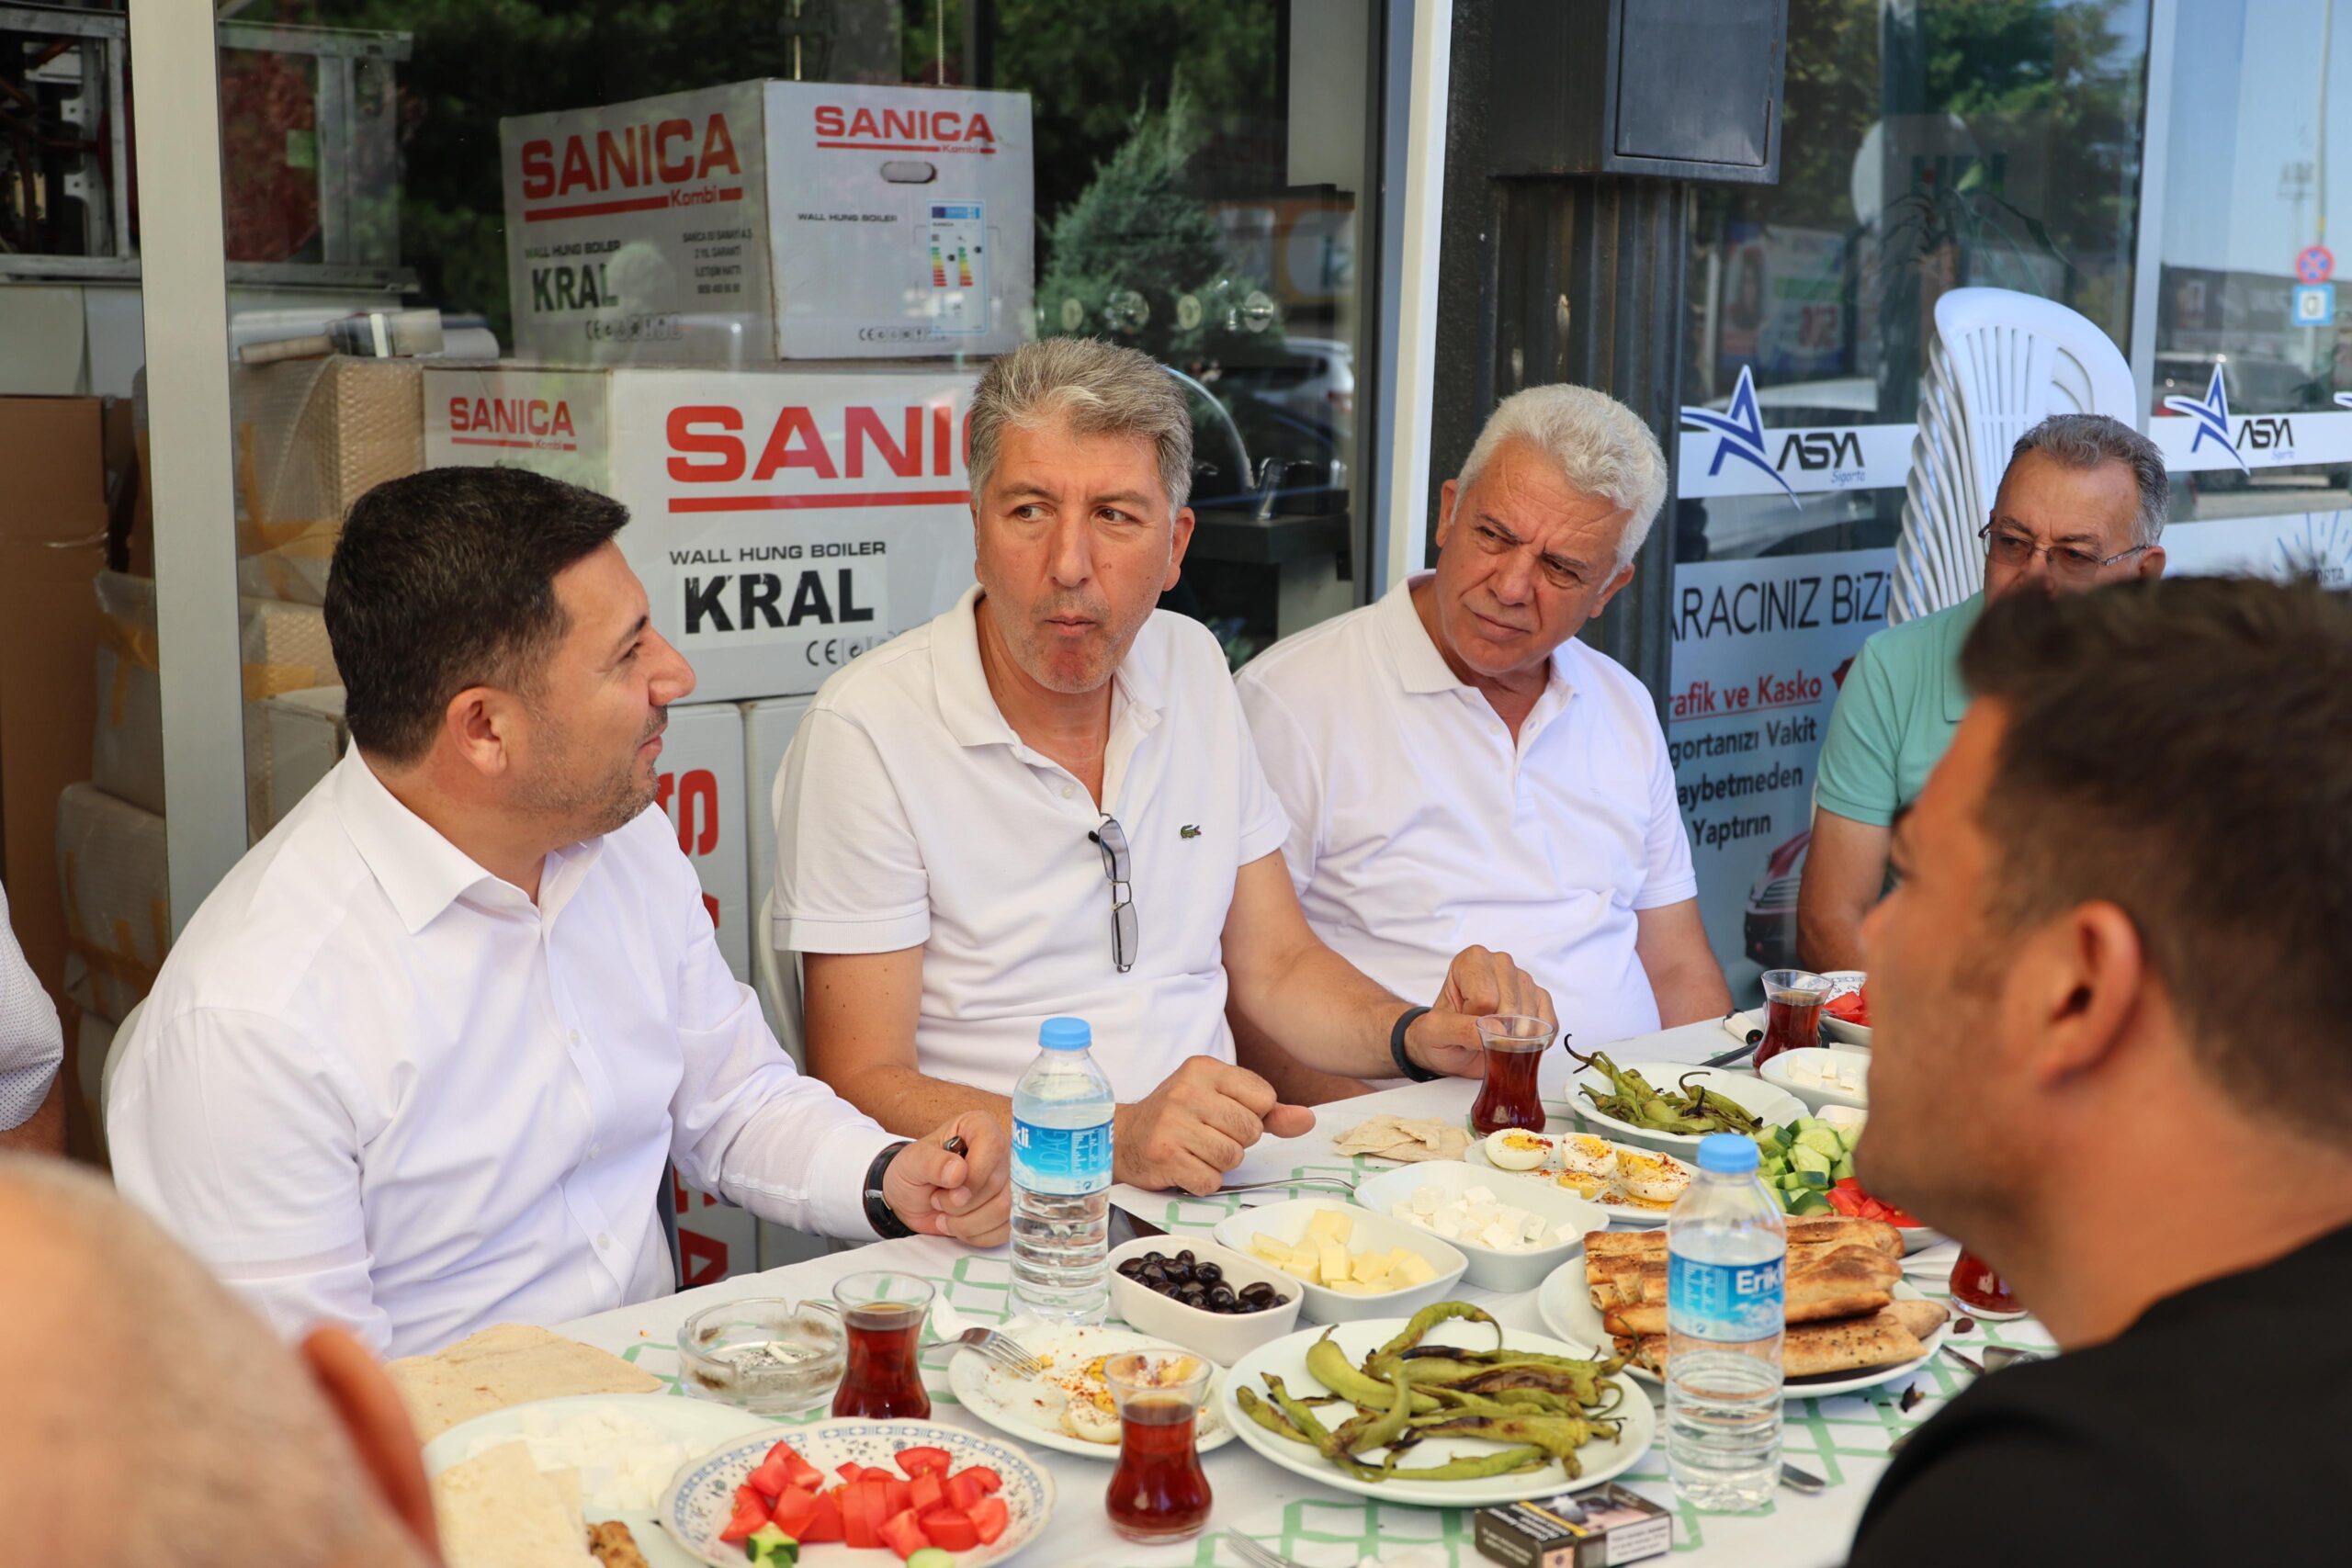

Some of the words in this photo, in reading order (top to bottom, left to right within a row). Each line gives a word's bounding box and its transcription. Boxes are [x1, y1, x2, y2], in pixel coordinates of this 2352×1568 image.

[815, 106, 996, 143] SANICA
[521, 112, 741, 200] SANICA
[942, 143, 978, 155] Kombi
[671, 186, 719, 208] Kombi
[797, 212, 826, 221] WALL
[829, 212, 859, 222] HUNG
[862, 213, 898, 222] BOILER
[552, 243, 582, 256] HUNG
[583, 240, 621, 254] BOILER
[531, 262, 619, 312] KRAL
[449, 396, 575, 437] SANICA
[535, 438, 563, 451] Kombi
[666, 405, 972, 483] SANI
[1776, 432, 1865, 471] ASYA
[670, 549, 732, 566] WALL
[740, 545, 803, 562] HUNG
[810, 541, 887, 558] BOILER
[684, 568, 875, 635] KRAL
[1723, 685, 1750, 710] ve
[1757, 669, 1823, 705] Kasko
[1767, 716, 1817, 748] Vakit
[1692, 814, 1772, 852] Yaptırın
